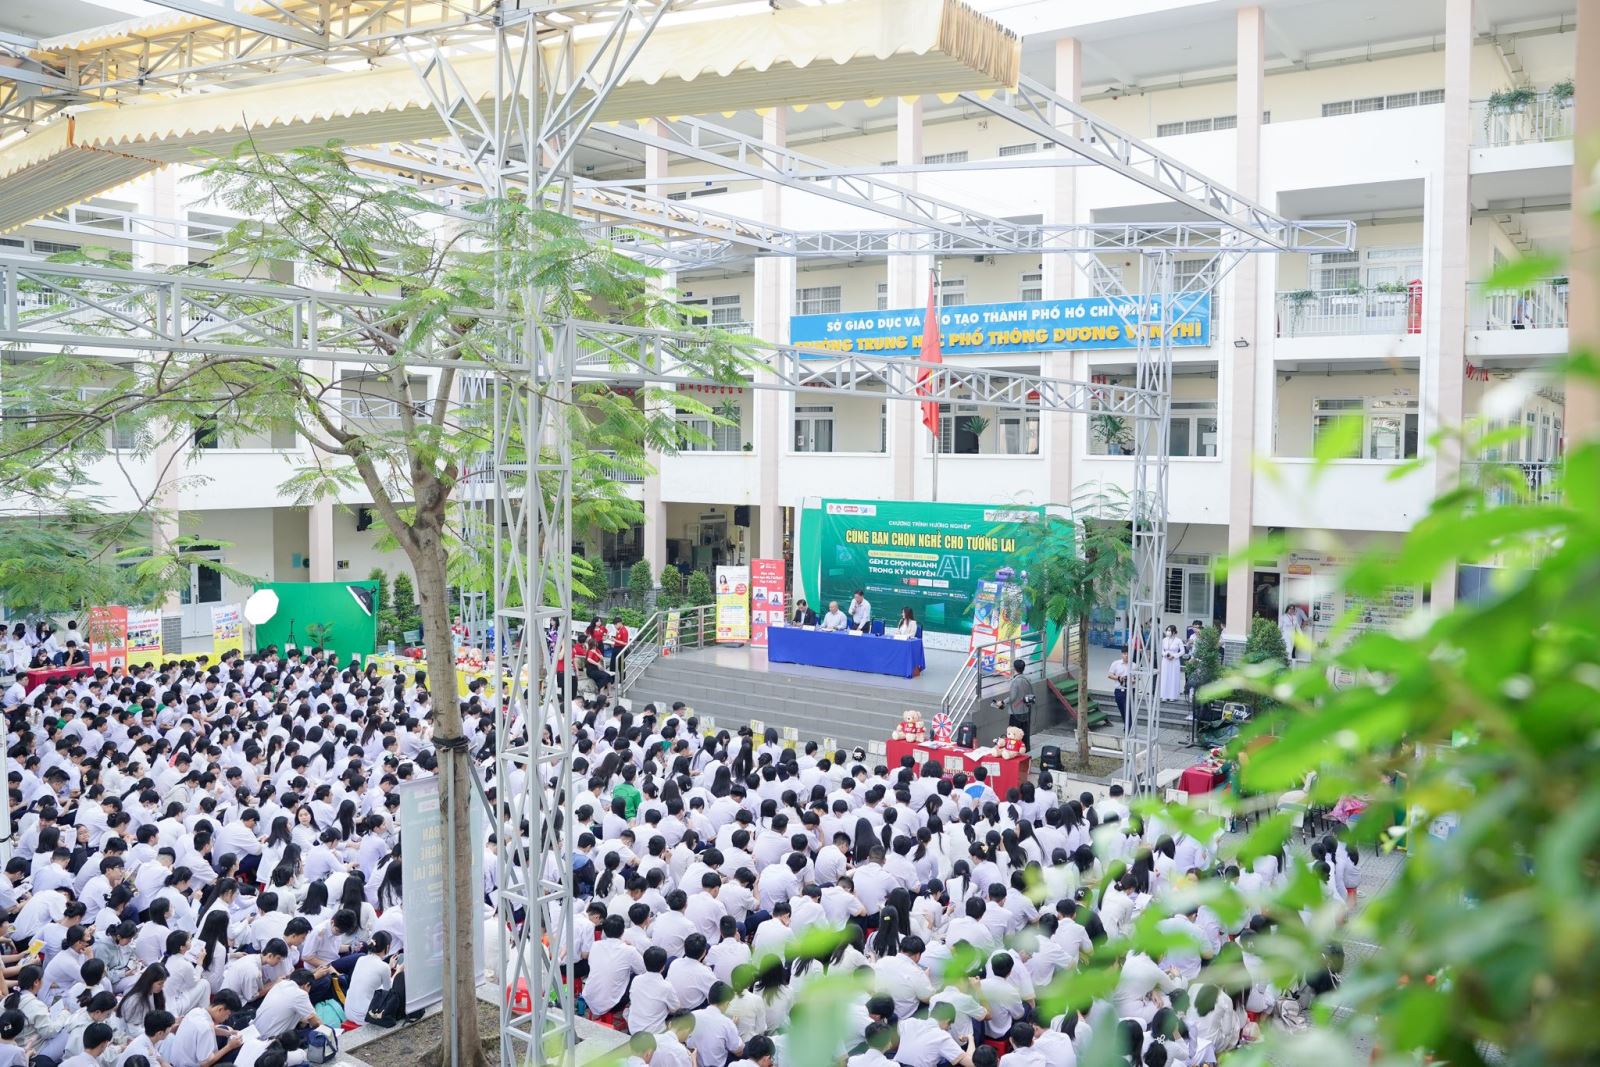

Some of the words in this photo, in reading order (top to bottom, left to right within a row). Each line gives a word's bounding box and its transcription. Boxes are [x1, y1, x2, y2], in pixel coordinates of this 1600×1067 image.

[827, 319, 842, 332] SỞ
[845, 317, 874, 330] GIÁO
[878, 316, 901, 330] DỤC
[903, 314, 920, 327] VÀ
[955, 313, 979, 328] TẠO
[983, 308, 1027, 323] THÀNH
[1032, 305, 1060, 320] PHỐ
[856, 337, 908, 351] TRUNG
[911, 335, 945, 348] HC
[948, 326, 984, 347] PHỔ
[987, 327, 1049, 345] THÔNG
[1053, 325, 1120, 343] DƯƠNG
[871, 531, 889, 547] BẠN
[891, 532, 916, 548] CHỌN
[918, 529, 942, 548] NGHỀ
[944, 535, 964, 549] CHO
[1000, 538, 1016, 552] LAI
[868, 566, 893, 574] TRONG
[906, 569, 936, 577] NGUYÊN
[911, 560, 937, 569] NGÀNH
[935, 554, 971, 579] AI
